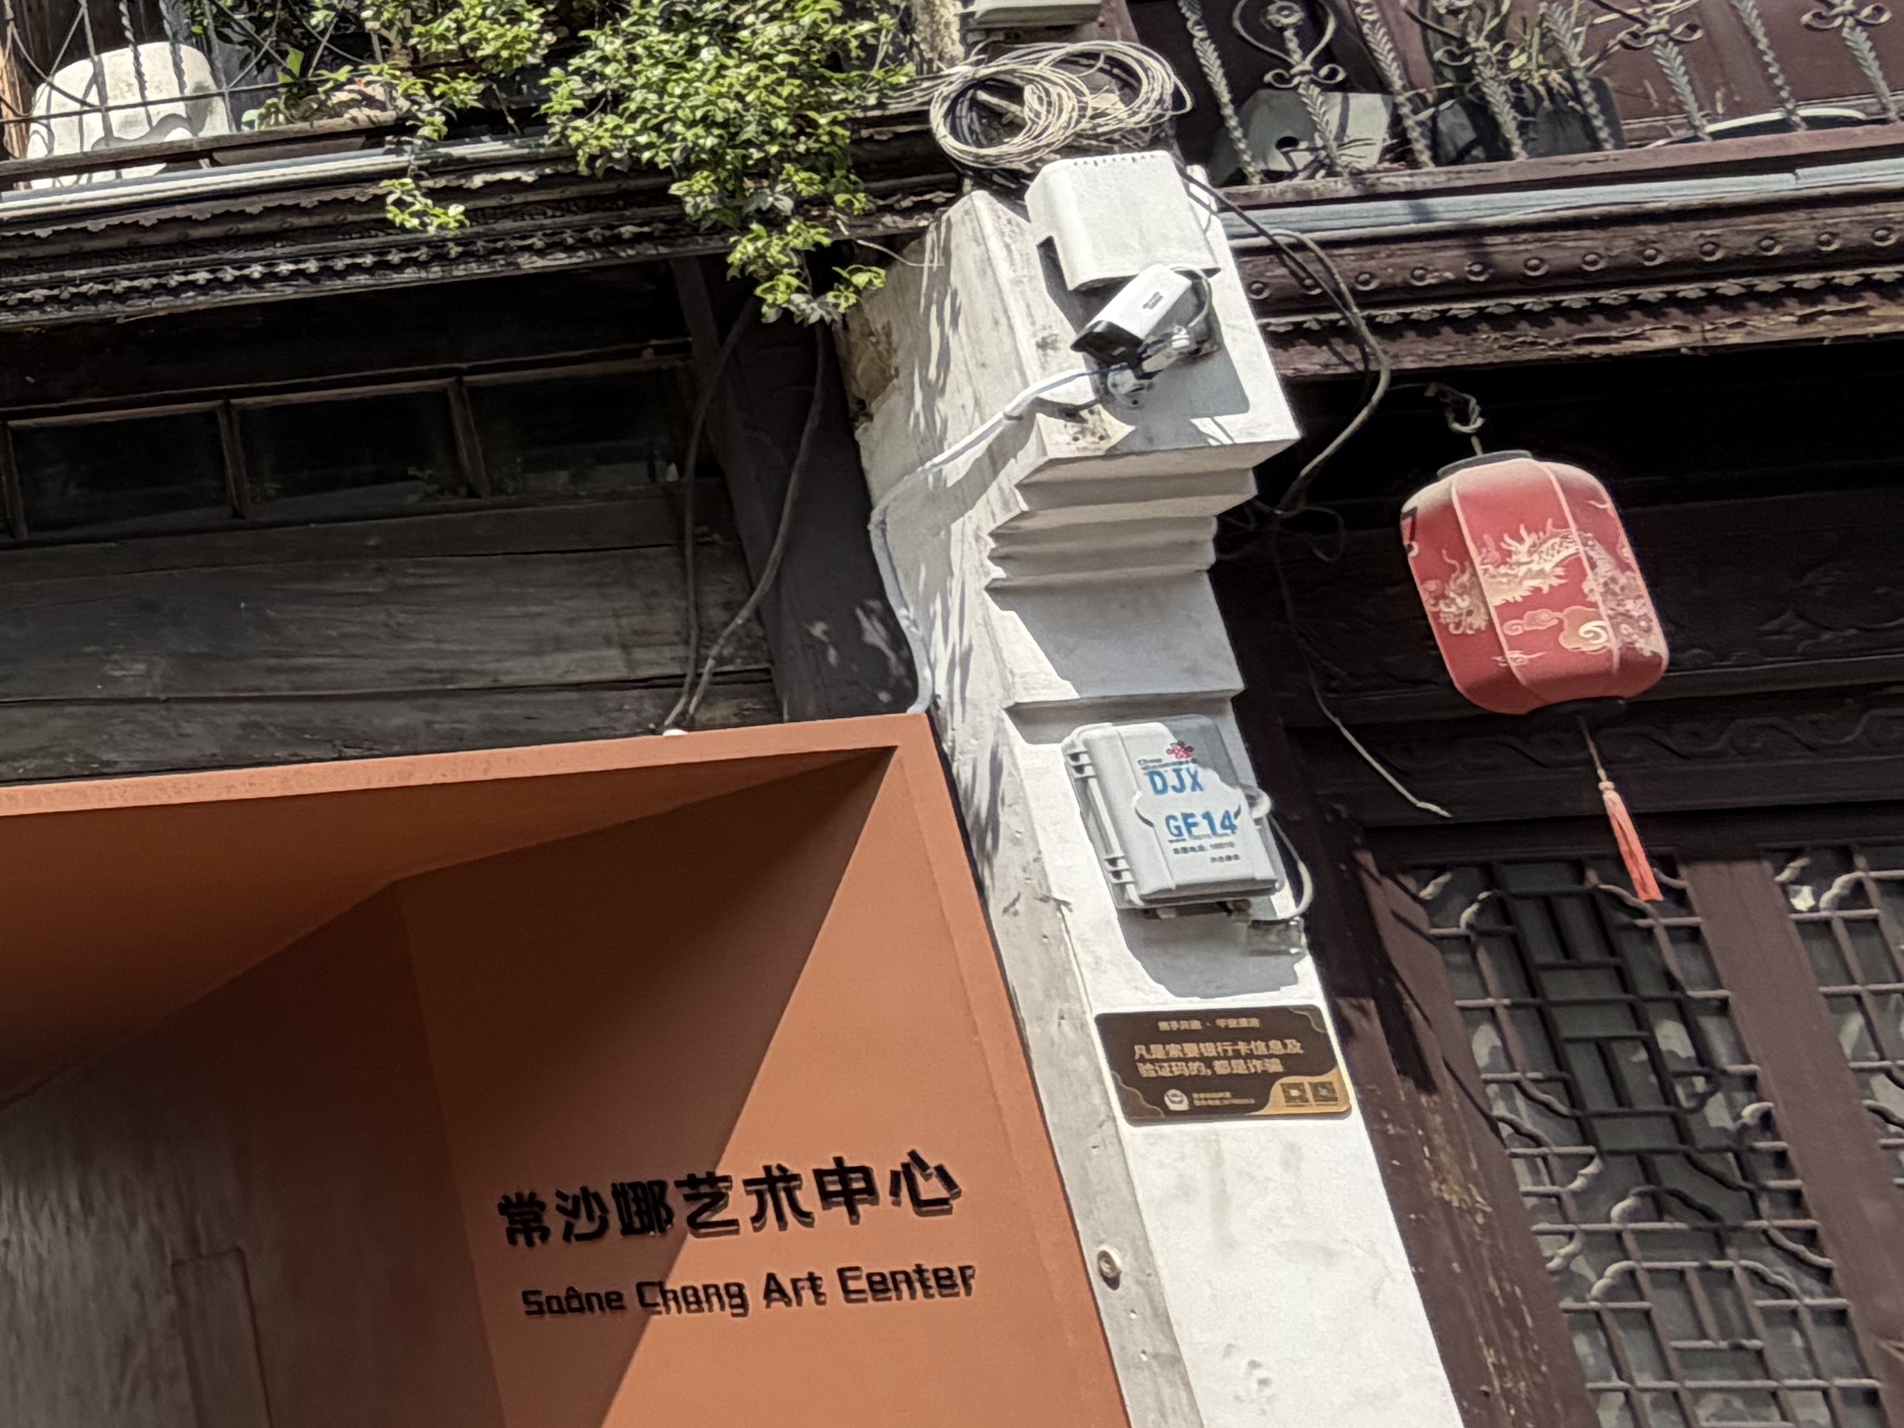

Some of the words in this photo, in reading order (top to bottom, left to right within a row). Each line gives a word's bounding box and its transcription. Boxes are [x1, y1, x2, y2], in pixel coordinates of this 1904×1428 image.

[1145, 766, 1204, 795] DJX
[1164, 809, 1238, 837] GF14
[497, 1149, 962, 1247] 常沙娜艺术中心
[635, 1279, 749, 1318] Chang
[763, 1270, 827, 1309] Art
[837, 1263, 976, 1305] Center
